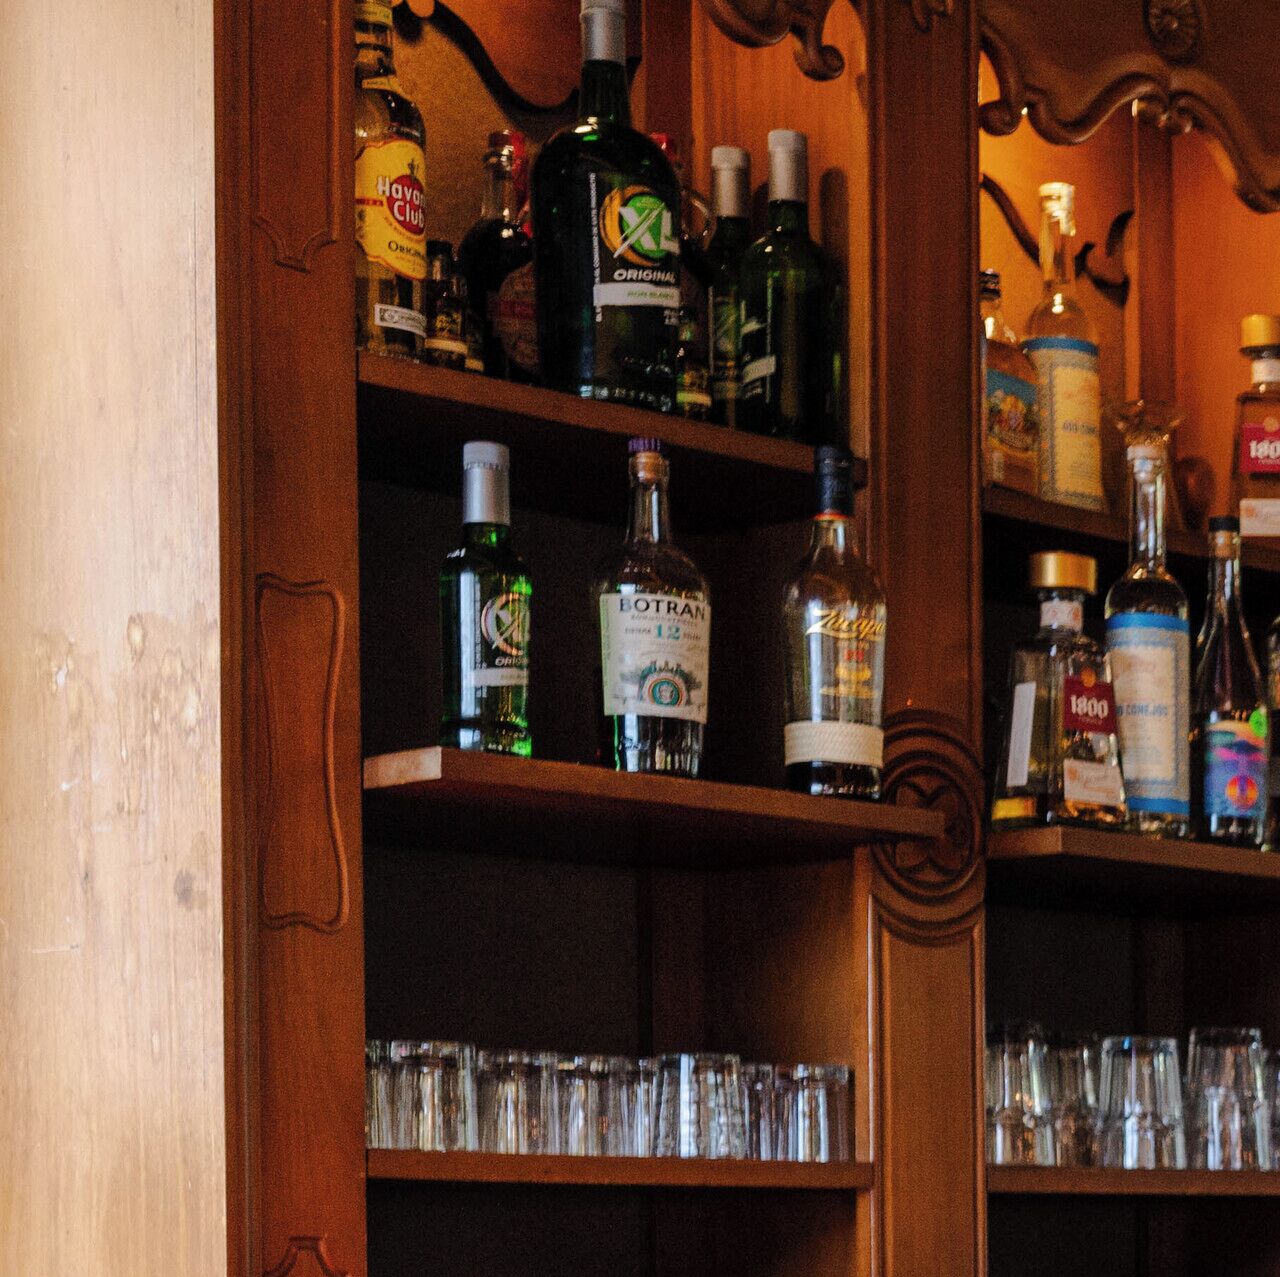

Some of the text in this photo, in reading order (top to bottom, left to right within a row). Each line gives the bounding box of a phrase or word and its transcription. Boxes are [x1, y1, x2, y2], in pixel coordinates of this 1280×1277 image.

[613, 268, 676, 284] ORIGINAL
[620, 598, 705, 621] BOTRAN
[1070, 694, 1109, 719] 1800
